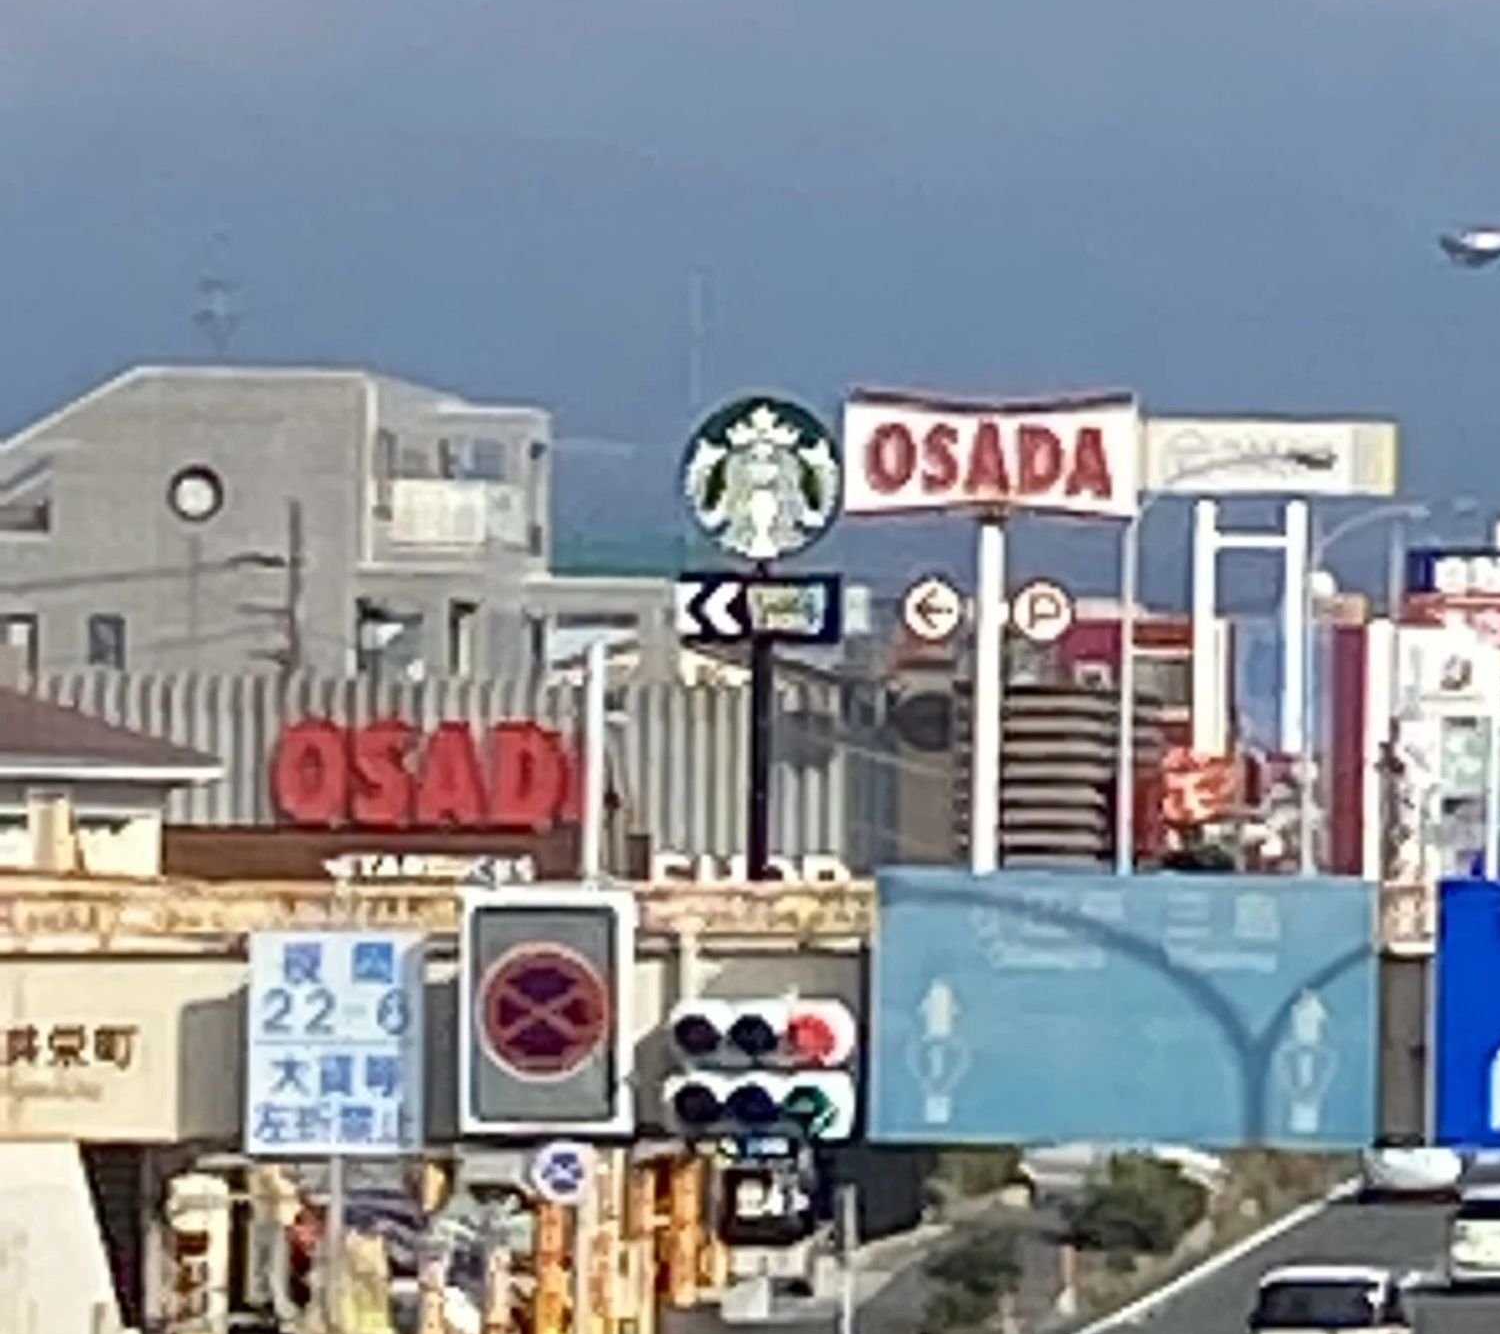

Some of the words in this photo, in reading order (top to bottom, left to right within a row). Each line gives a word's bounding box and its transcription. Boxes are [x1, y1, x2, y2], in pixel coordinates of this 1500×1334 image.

[865, 418, 1113, 502] OSADA
[272, 715, 585, 829] OSAD
[253, 1100, 416, 1146] 左折禁止
